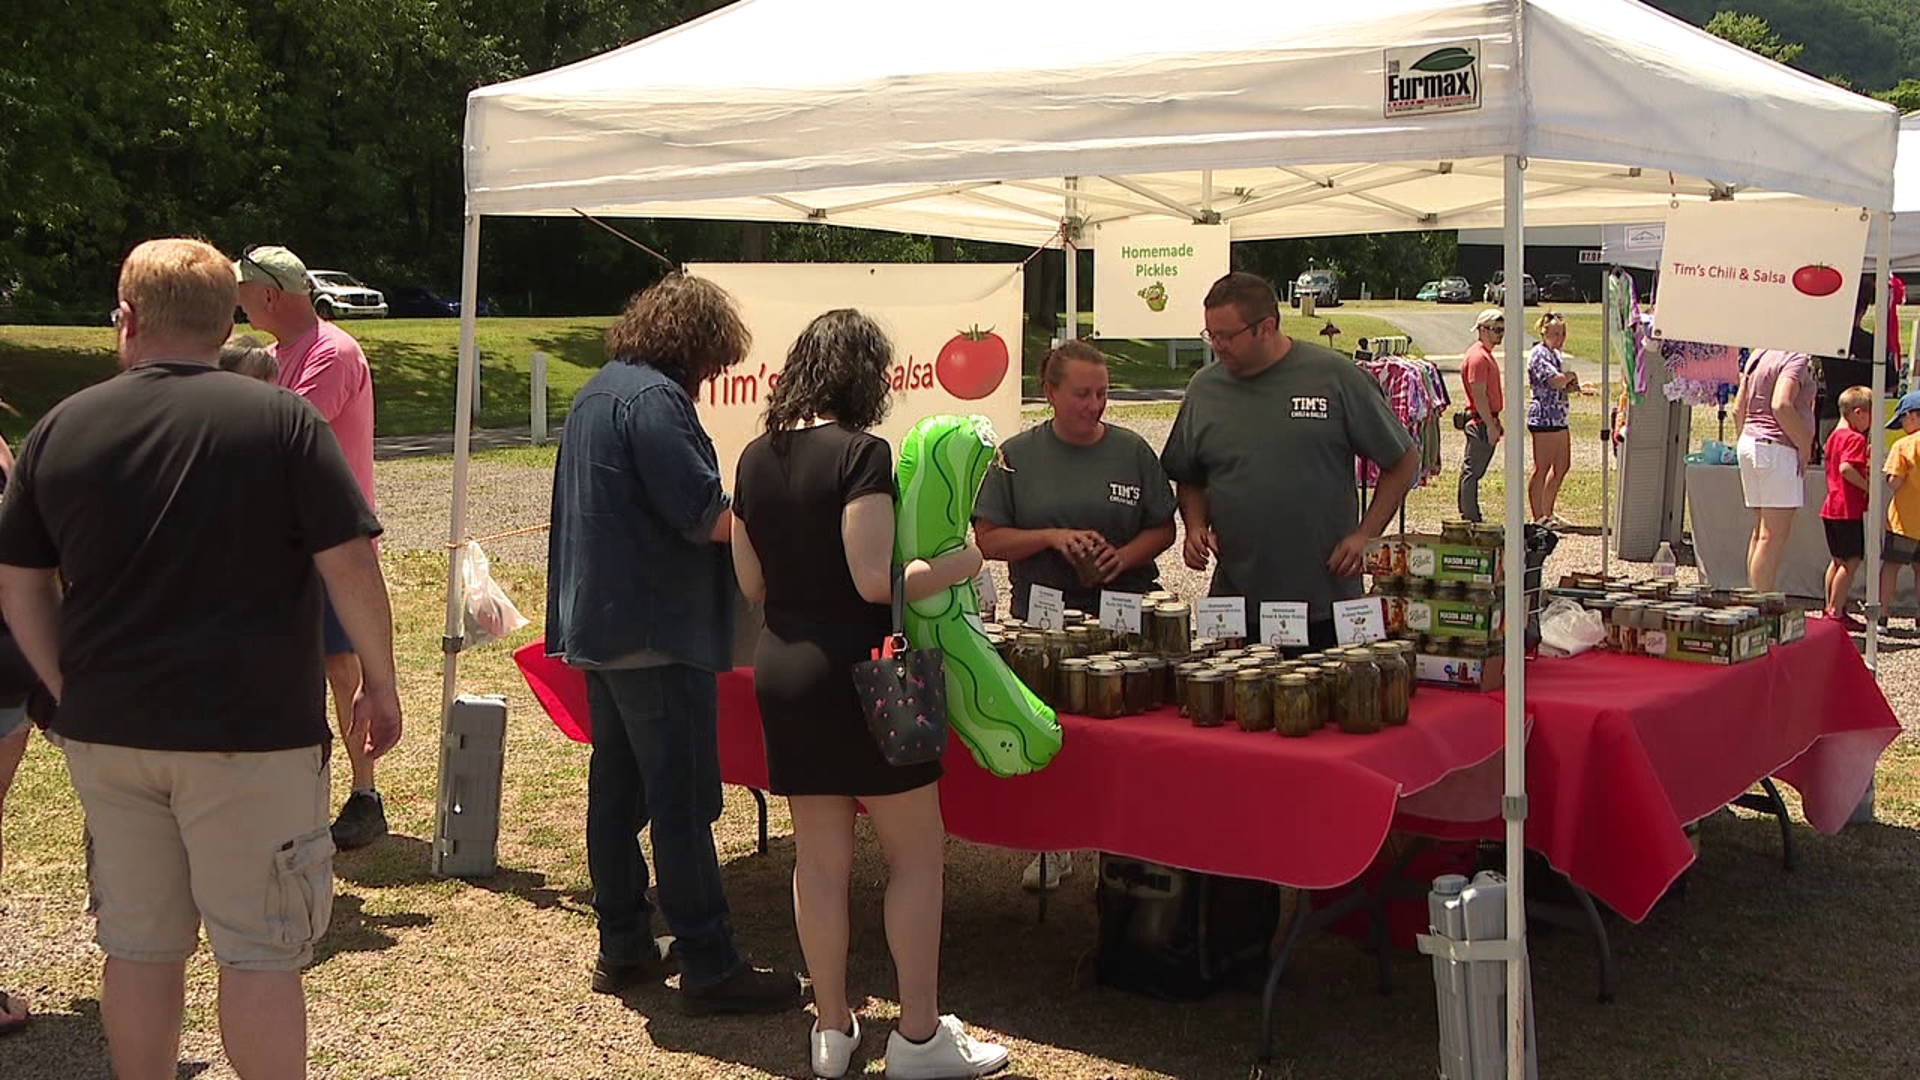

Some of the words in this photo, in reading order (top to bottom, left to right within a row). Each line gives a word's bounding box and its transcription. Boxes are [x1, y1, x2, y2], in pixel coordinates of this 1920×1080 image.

[1388, 71, 1471, 102] Eurmax
[1121, 243, 1194, 259] Homemade
[1136, 263, 1178, 277] Pickles
[1673, 262, 1705, 277] Tim's
[1708, 265, 1736, 279] Chili
[1739, 268, 1750, 281] &
[1753, 269, 1786, 284] Salsa
[1292, 397, 1327, 411] TIM'S
[1110, 483, 1140, 500] TIM'S
[1443, 557, 1463, 565] MASON
[1464, 558, 1478, 566] JARS
[1439, 611, 1460, 620] MASON
[1460, 612, 1474, 621] JARS
